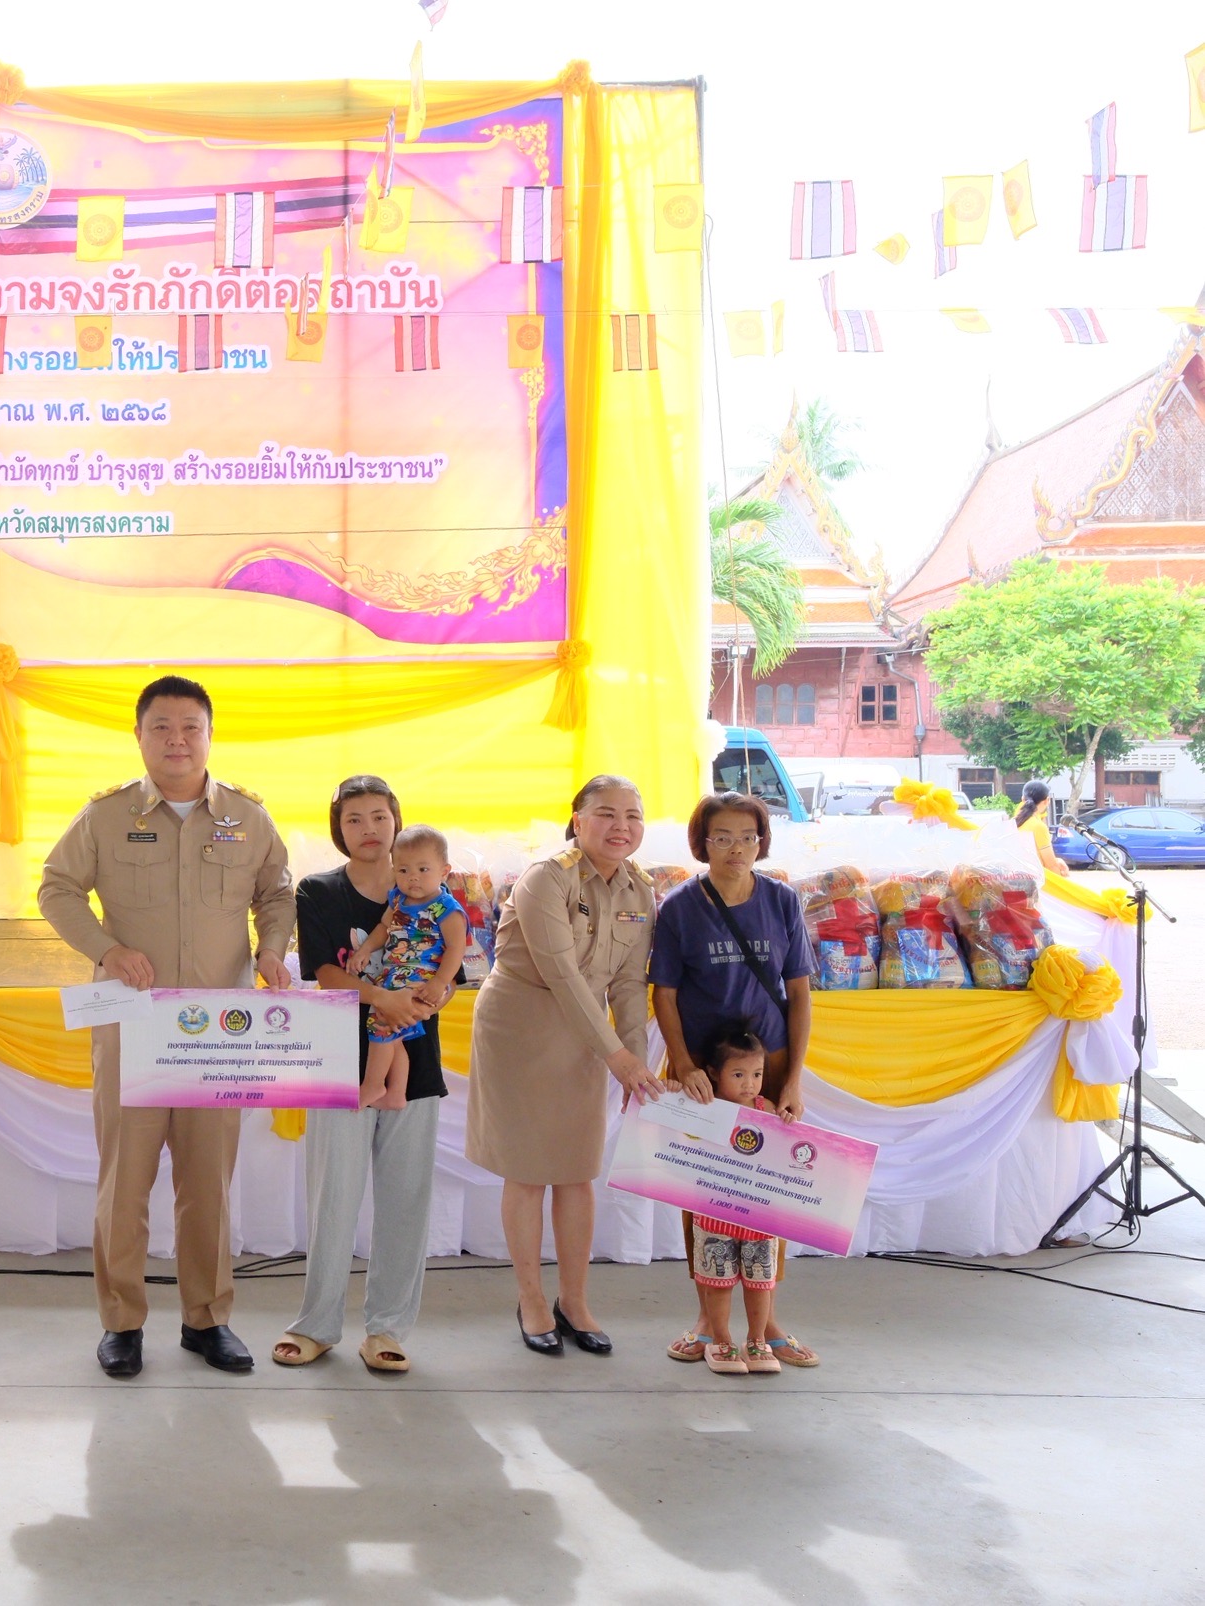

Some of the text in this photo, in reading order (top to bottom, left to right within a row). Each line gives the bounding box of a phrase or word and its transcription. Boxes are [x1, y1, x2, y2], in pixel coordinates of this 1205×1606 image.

[45, 398, 90, 422] พ.ศ.
[101, 401, 167, 422] ๒๕๖๘
[87, 456, 164, 490] บำรุงสุข
[708, 941, 734, 955] NEW
